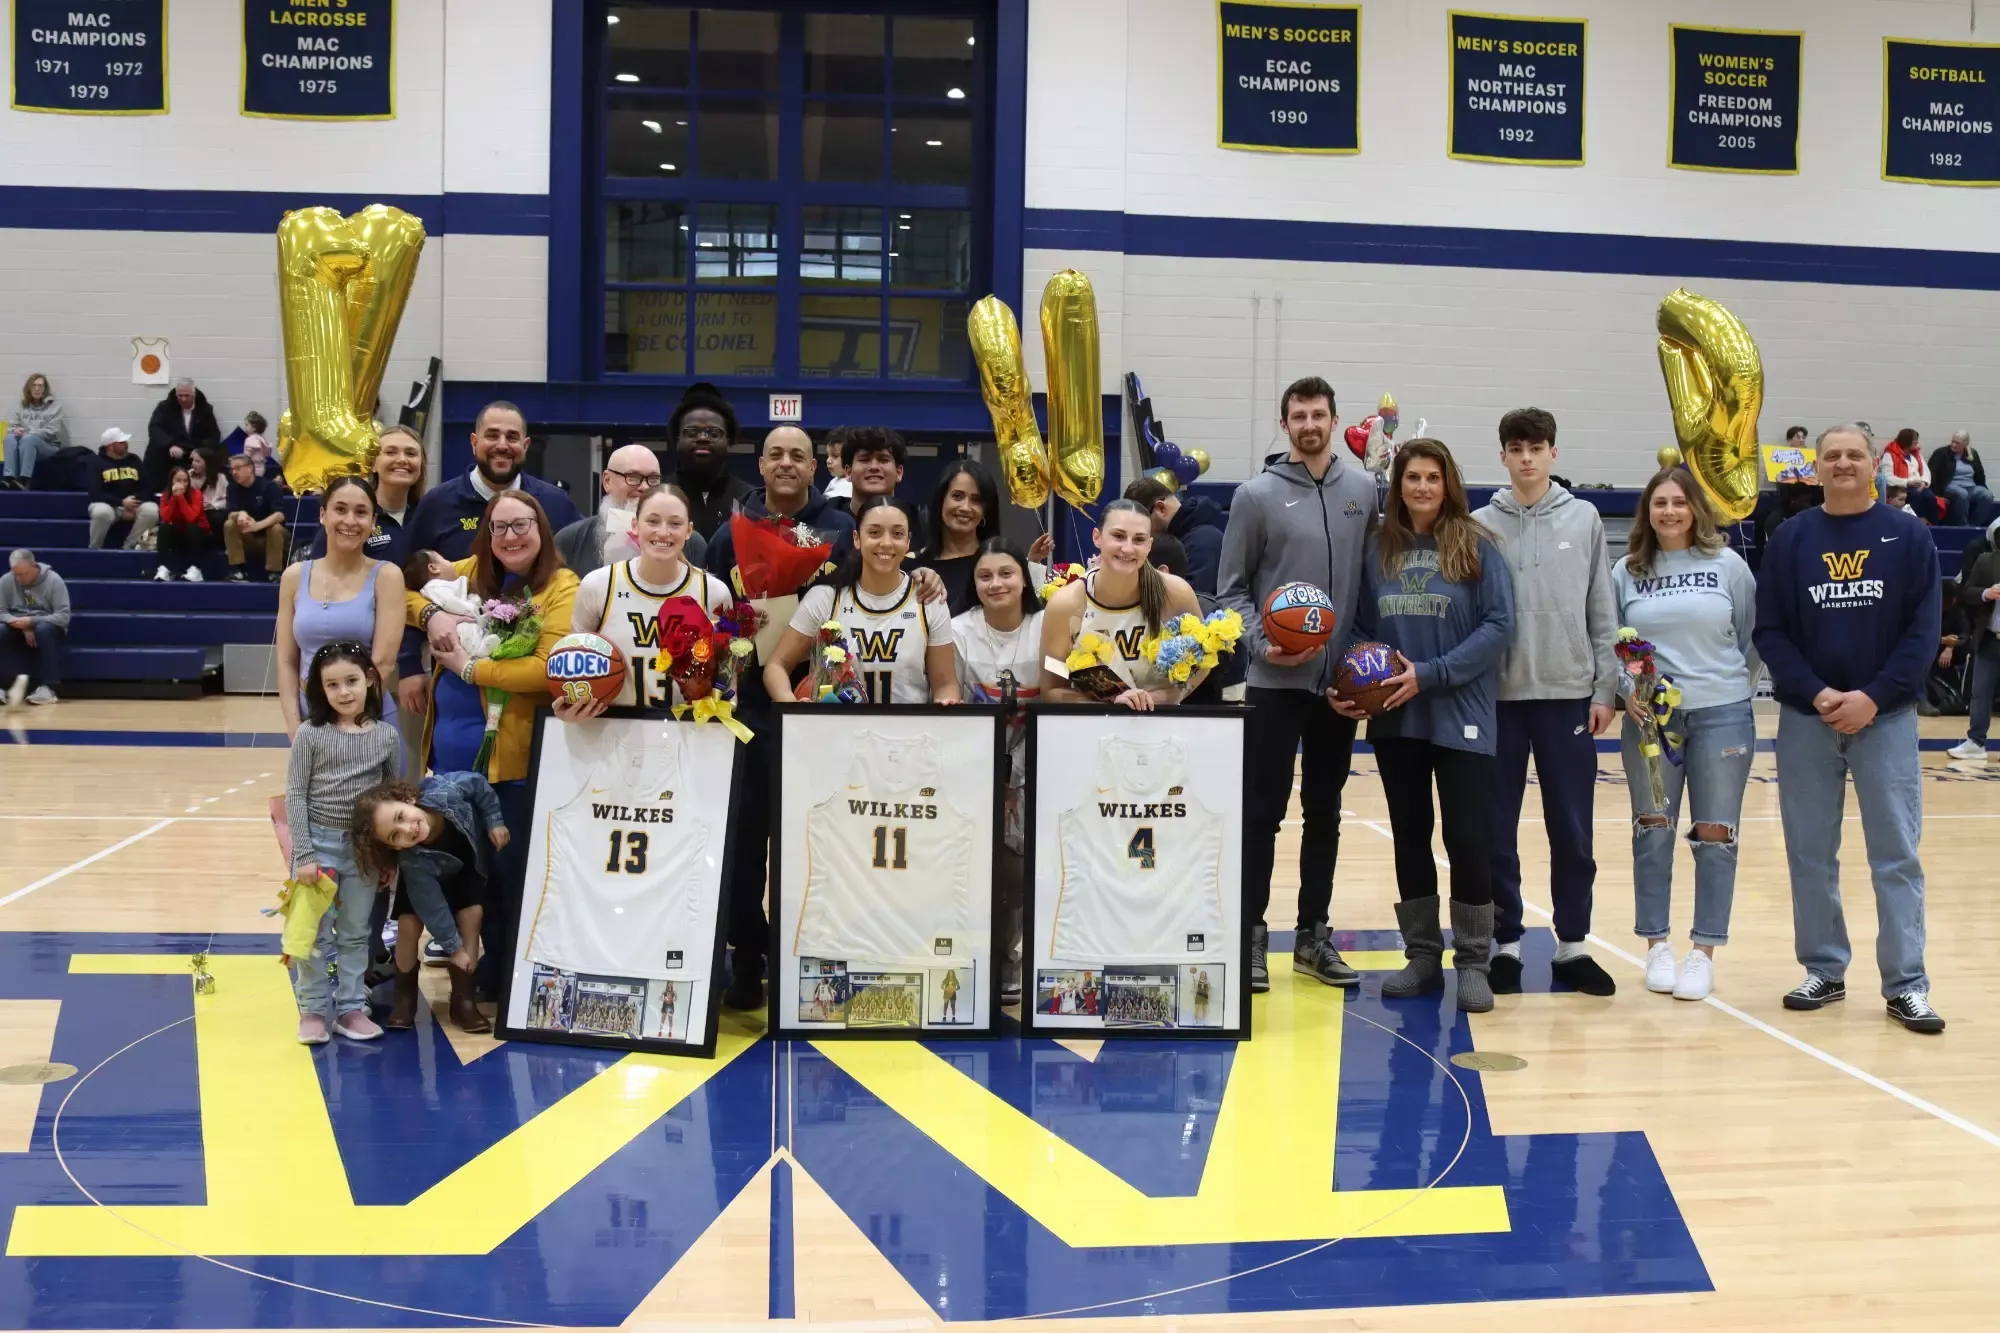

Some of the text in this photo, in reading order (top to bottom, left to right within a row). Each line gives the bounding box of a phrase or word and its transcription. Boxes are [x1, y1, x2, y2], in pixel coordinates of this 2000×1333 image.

[68, 12, 111, 27] MAC
[270, 10, 368, 27] LACROSSE
[31, 29, 147, 47] CHAMPIONS
[1226, 23, 1352, 43] MEN'S SOCCER
[297, 37, 340, 51] MAC
[1457, 35, 1578, 57] MEN'S SOCCER
[35, 59, 143, 76] 1971 1972
[261, 53, 373, 70] CHAMPIONS
[1266, 59, 1312, 75] ECAC
[1698, 53, 1775, 71] WOMEN'S
[1499, 63, 1536, 78] MAC
[1909, 66, 1986, 83] SOFTBALL
[298, 80, 337, 94] 1975
[1239, 75, 1341, 93] CHAMPIONS
[1468, 79, 1566, 97] NORTHEAST
[1704, 71, 1768, 88] SOCCER
[69, 84, 109, 99] 1979
[1468, 96, 1568, 115] CHAMPIONS
[1698, 94, 1772, 111] FREEDOM
[1929, 102, 1964, 116] MAC
[1269, 110, 1308, 125] 1990
[1688, 110, 1782, 129] CHAMPIONS
[1901, 116, 1993, 134] CHAMPIONS
[1499, 128, 1535, 142] 1992
[1718, 134, 1756, 149] 2005
[1929, 153, 1962, 166] 1982
[732, 311, 752, 326] TO
[636, 334, 661, 352] BE
[773, 399, 798, 416] EXIT
[460, 517, 479, 531] W
[1822, 549, 1870, 580] W
[1633, 572, 1719, 595] WILKES
[1808, 580, 1885, 604] WILKES
[1377, 593, 1451, 619] UNIVERSITY
[1821, 600, 1873, 609] BASKETBALL
[851, 628, 905, 663] W
[547, 651, 610, 678] HOLDEN
[592, 803, 674, 823] WILKES
[848, 799, 937, 819] WILKES
[1098, 802, 1187, 818] WILKES
[605, 829, 650, 875] 13
[872, 825, 908, 870] 11
[1127, 826, 1155, 870] 4
